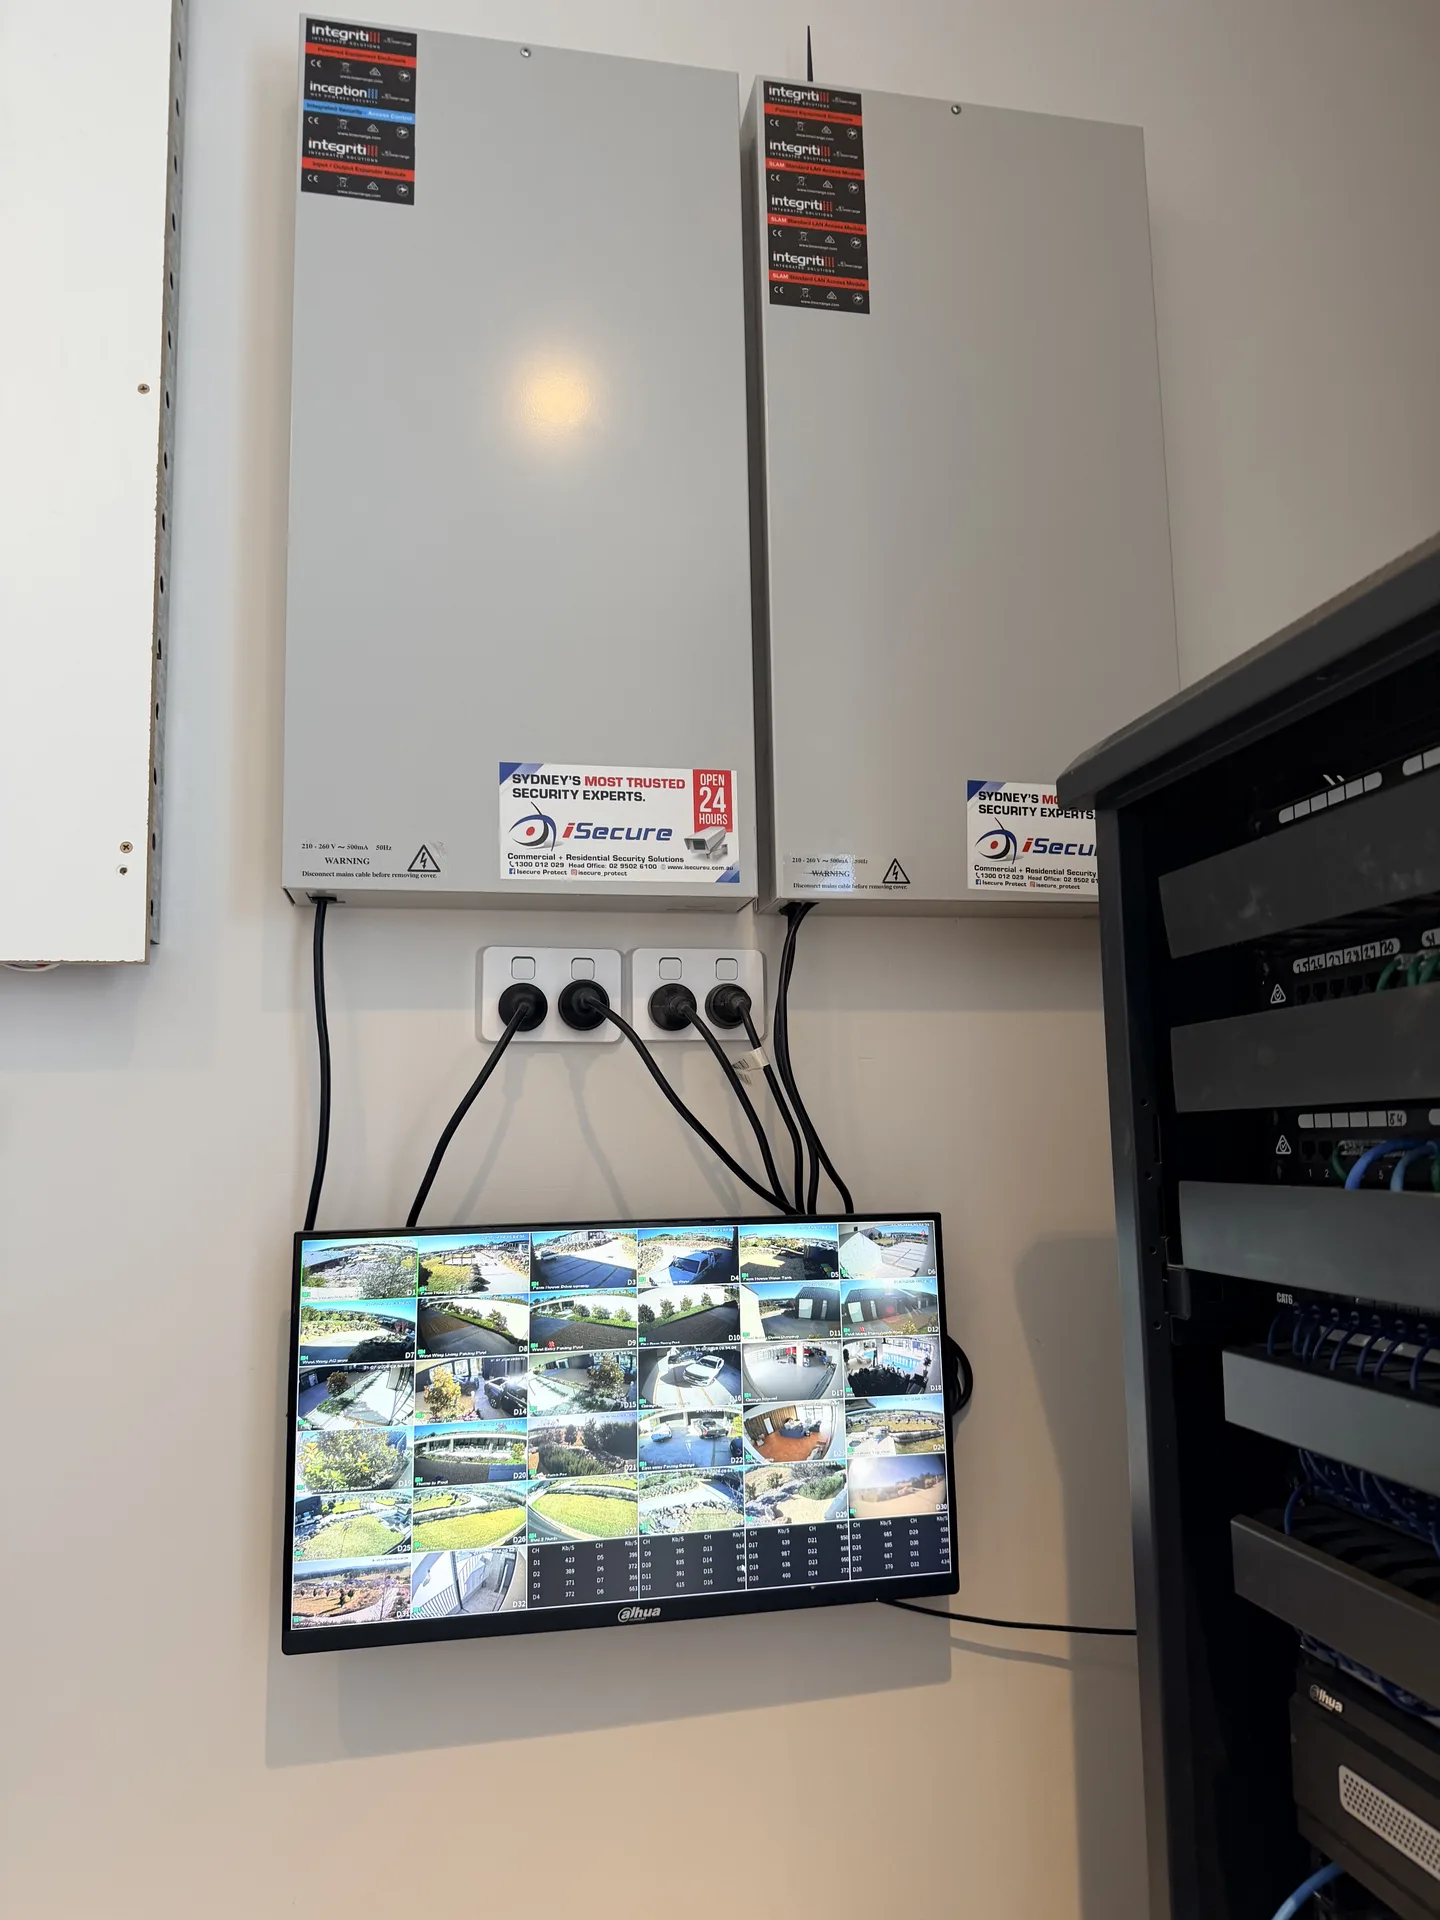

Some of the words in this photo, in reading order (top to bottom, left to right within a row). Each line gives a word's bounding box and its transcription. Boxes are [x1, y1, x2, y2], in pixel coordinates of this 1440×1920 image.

[310, 81, 367, 98] inception
[769, 85, 820, 102] integriti
[308, 138, 366, 155] integriti
[769, 139, 820, 156] integriti
[771, 194, 822, 211] integriti
[773, 251, 824, 267] integriti
[512, 773, 581, 786] SYDNEY'S
[584, 775, 623, 787] MOST
[626, 777, 686, 789] TRUSTED
[700, 773, 725, 787] OPEN
[512, 788, 579, 800] SECURITY
[583, 789, 646, 802] EXPERTS.
[699, 786, 726, 813] 24
[978, 791, 1039, 804] SYDNEY'S
[978, 804, 1037, 816] SECURITY
[699, 813, 728, 825] HOURS
[562, 822, 673, 841] iSecure
[1022, 838, 1097, 857] iSecu
[325, 857, 370, 865] WARNING
[507, 852, 556, 860] Commercial
[566, 853, 610, 861] Residential
[612, 854, 646, 863] Security
[648, 855, 685, 863] Solutions
[578, 869, 628, 877] isecure_protect
[974, 864, 1017, 873] Commercial
[1025, 867, 1065, 876] Residential
[1067, 869, 1097, 878] Security
[1276, 1292, 1293, 1305] CAT6
[624, 1401, 637, 1409] D15
[514, 1408, 527, 1416] D14
[514, 1472, 527, 1480] D20
[935, 1503, 948, 1511] D30
[512, 1536, 526, 1544] D26
[512, 1600, 526, 1608] D32
